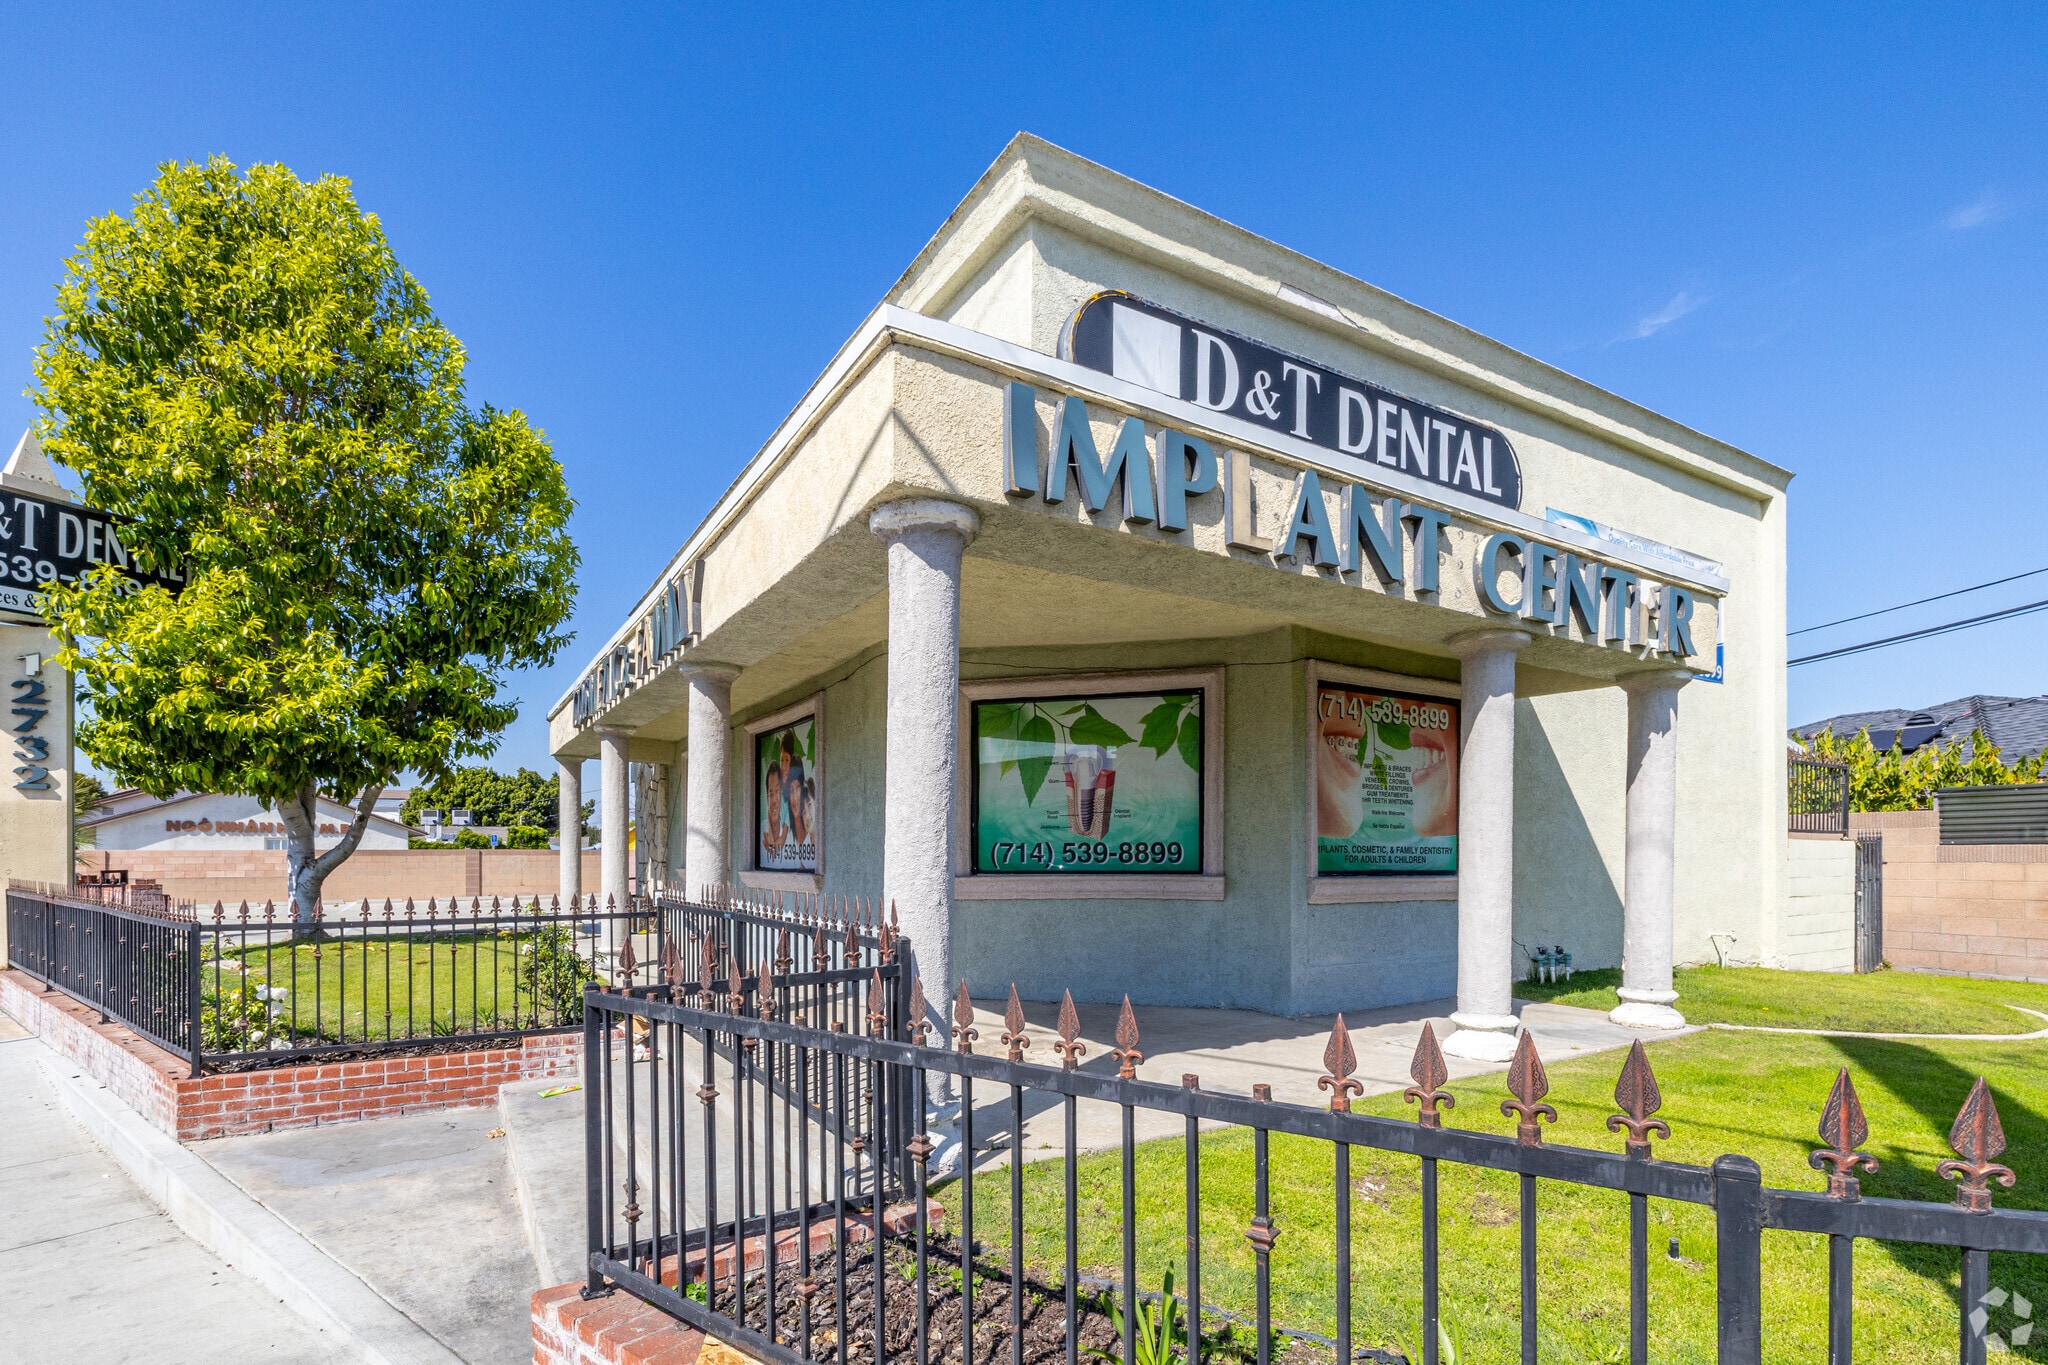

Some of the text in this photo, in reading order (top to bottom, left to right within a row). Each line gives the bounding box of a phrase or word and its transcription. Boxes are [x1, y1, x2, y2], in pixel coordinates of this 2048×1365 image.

[1191, 328, 1502, 498] D&T DENTAL
[1003, 380, 1698, 657] IMPLANT CENTER
[11, 652, 51, 790] 12732
[1317, 692, 1449, 731] (714) 539-8899
[1386, 771, 1406, 779] FILLINGS
[165, 817, 213, 832] NGÔ
[215, 818, 273, 834] NHÂN
[784, 843, 816, 861] 539-8899
[991, 841, 1185, 869] (714) 539-8899
[1345, 855, 1426, 864] FOR ADULTS & CHILDREN
[1390, 846, 1395, 854] &
[1396, 846, 1419, 854] FAMILY
[1419, 846, 1453, 855] DENTISTRY
